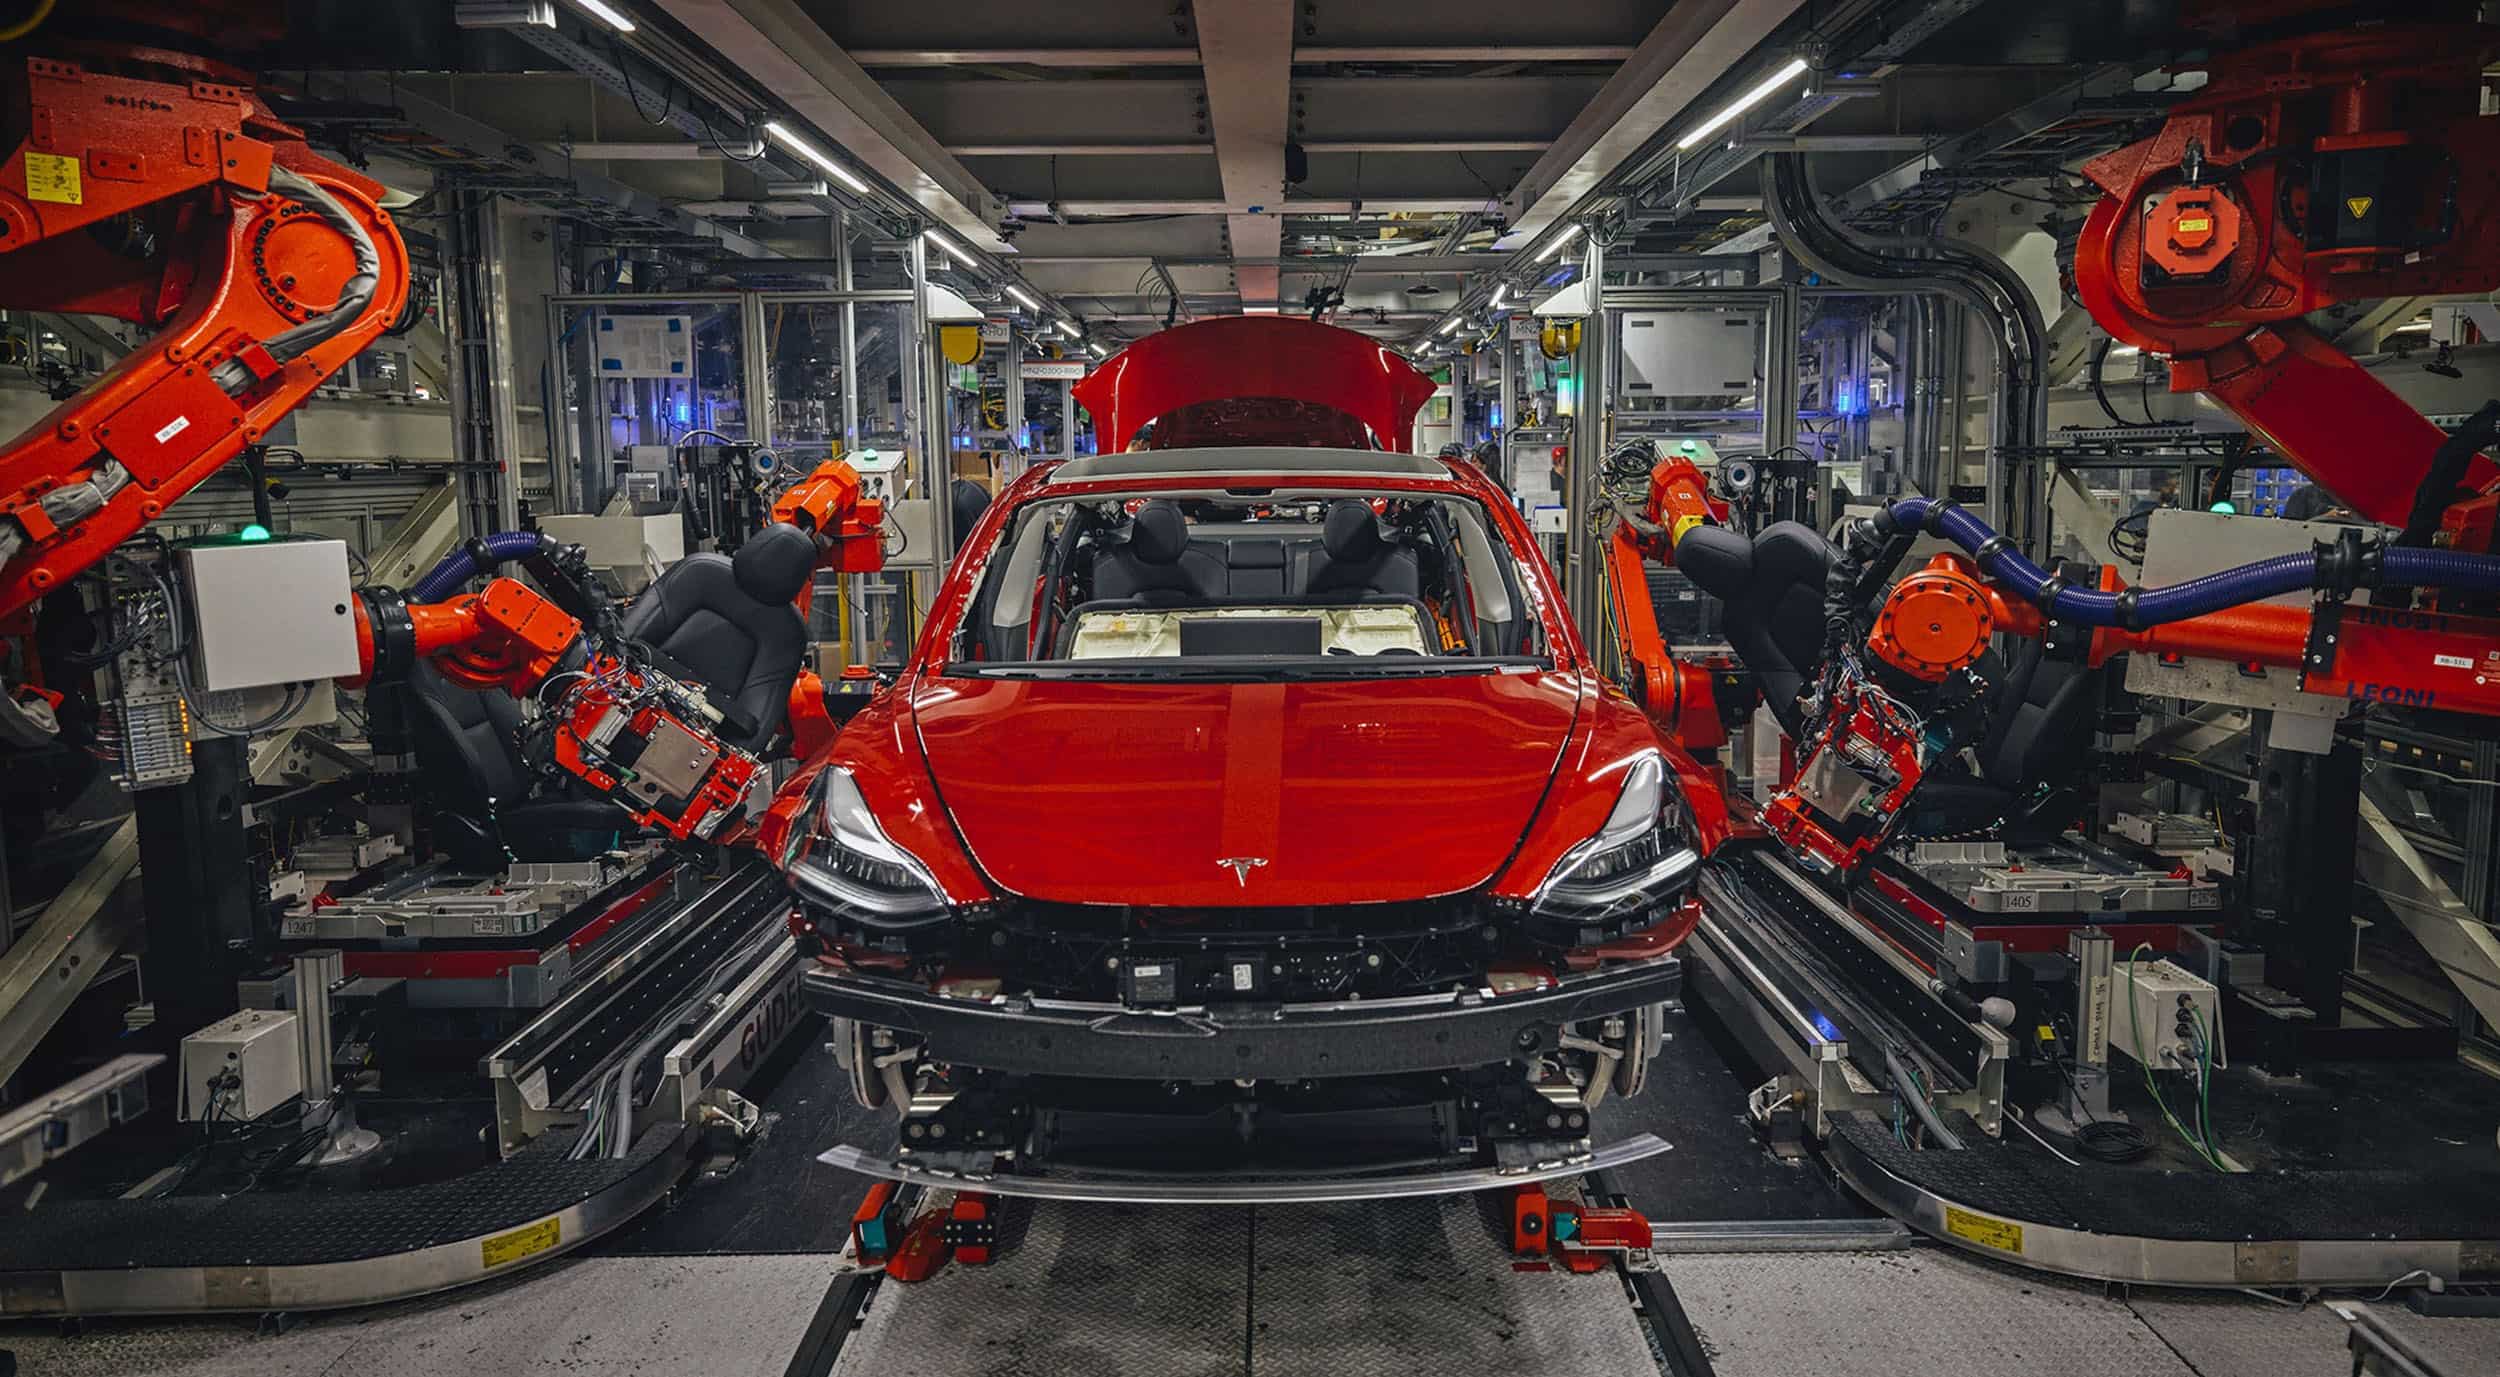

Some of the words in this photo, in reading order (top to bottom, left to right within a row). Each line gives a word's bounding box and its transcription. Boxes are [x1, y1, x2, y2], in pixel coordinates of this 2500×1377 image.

[2346, 680, 2437, 706] LEONI
[2006, 895, 2032, 908] 1405
[741, 970, 805, 1072] GÜDEL
